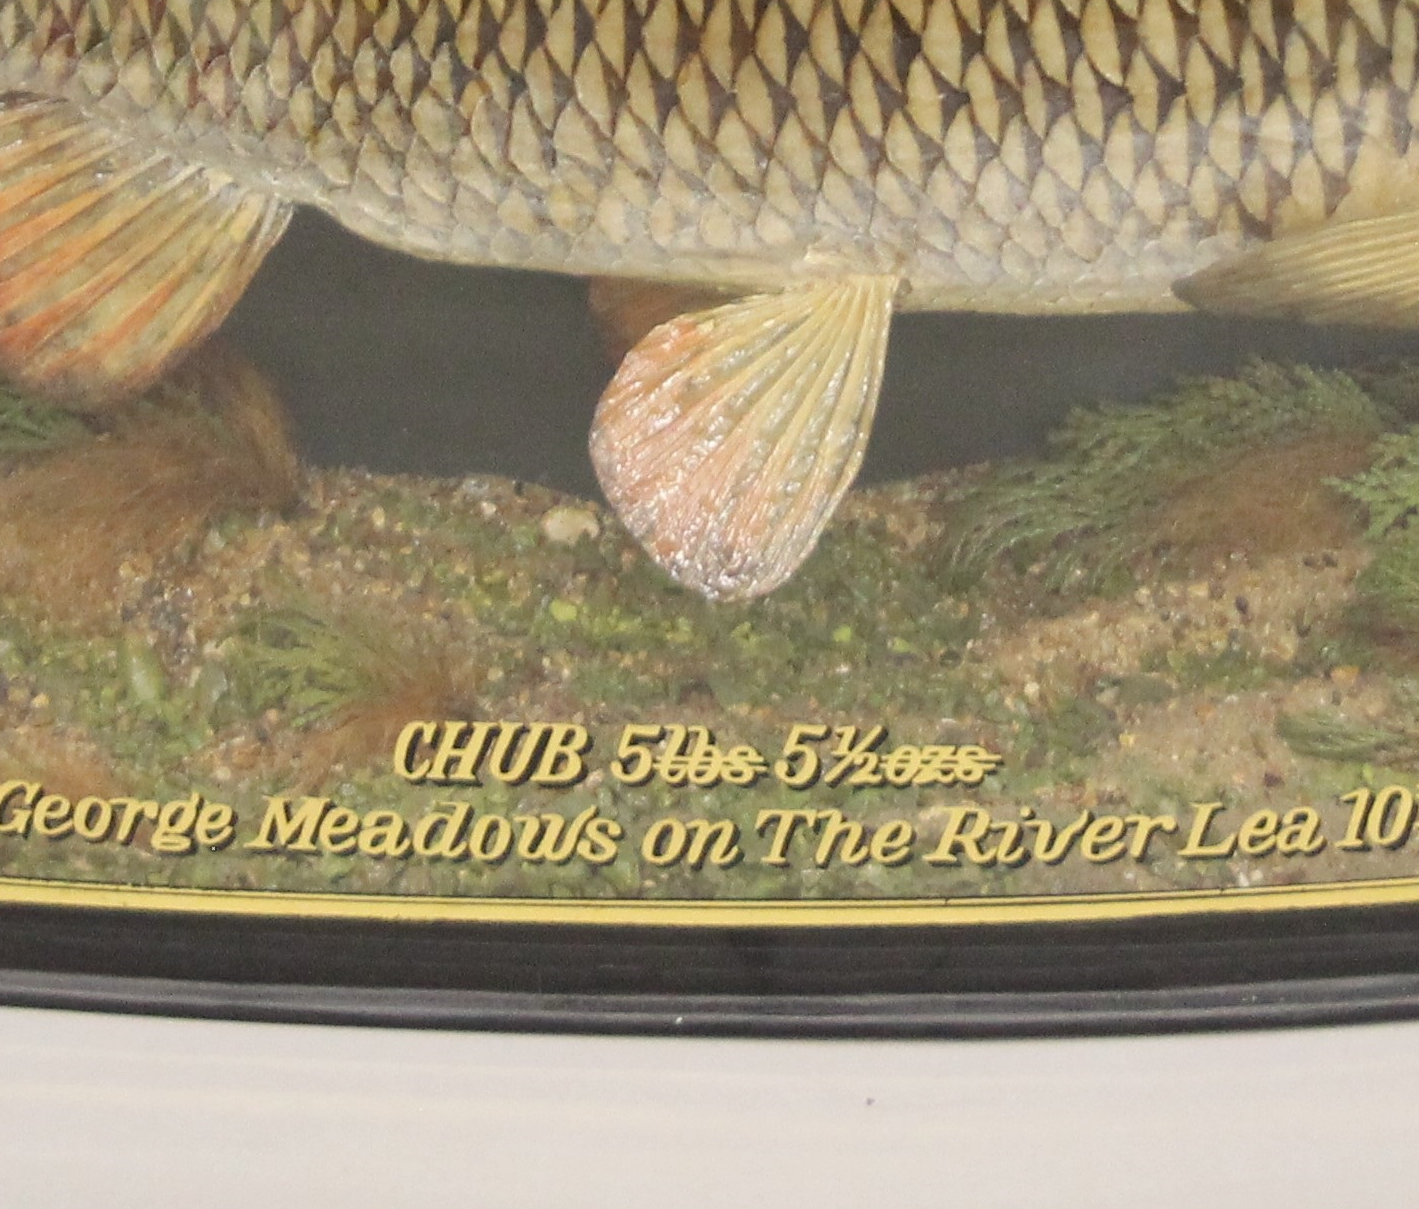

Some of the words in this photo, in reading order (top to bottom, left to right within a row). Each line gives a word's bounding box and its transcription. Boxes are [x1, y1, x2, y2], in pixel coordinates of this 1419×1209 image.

[394, 720, 590, 784] CHUB
[244, 794, 623, 863] Meadows
[641, 816, 741, 867] on
[755, 808, 914, 865] The
[922, 805, 1178, 864] River
[1177, 801, 1325, 858] Lea
